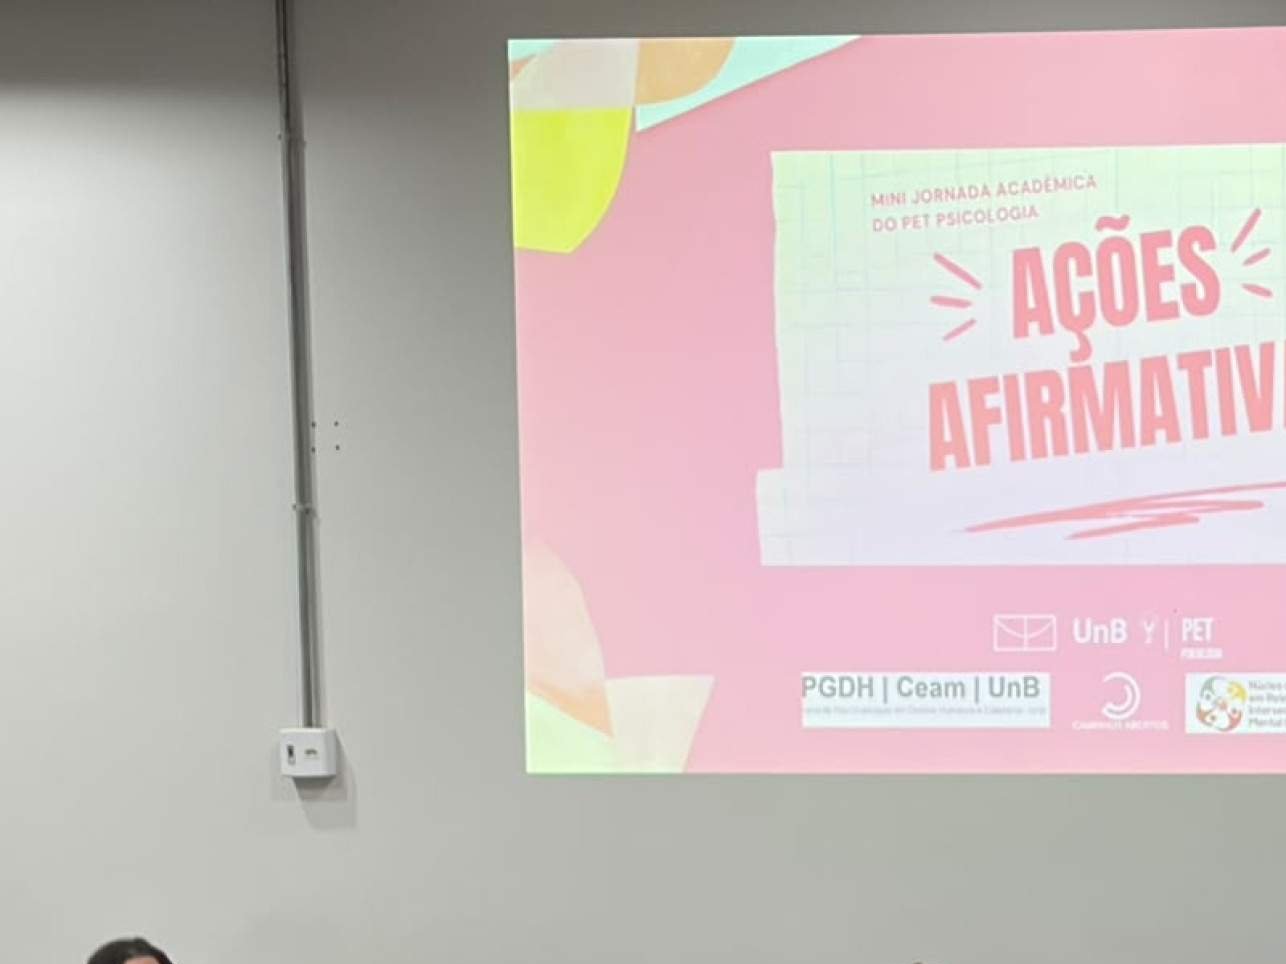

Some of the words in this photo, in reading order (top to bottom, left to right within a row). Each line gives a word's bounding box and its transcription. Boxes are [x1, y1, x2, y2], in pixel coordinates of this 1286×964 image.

[871, 191, 907, 207] MINI
[911, 183, 991, 205] JORNADA
[996, 173, 1098, 197] ACADÊMICA
[872, 216, 898, 232] DO
[902, 214, 931, 230] PET
[936, 205, 1039, 227] PSICOLOGIA
[1011, 214, 1221, 363] AÇÕES
[1072, 616, 1128, 644] UnB
[1181, 617, 1215, 642] PET
[801, 675, 875, 699] PGDH
[896, 675, 966, 699] Ceam
[988, 675, 1041, 699] UnB
